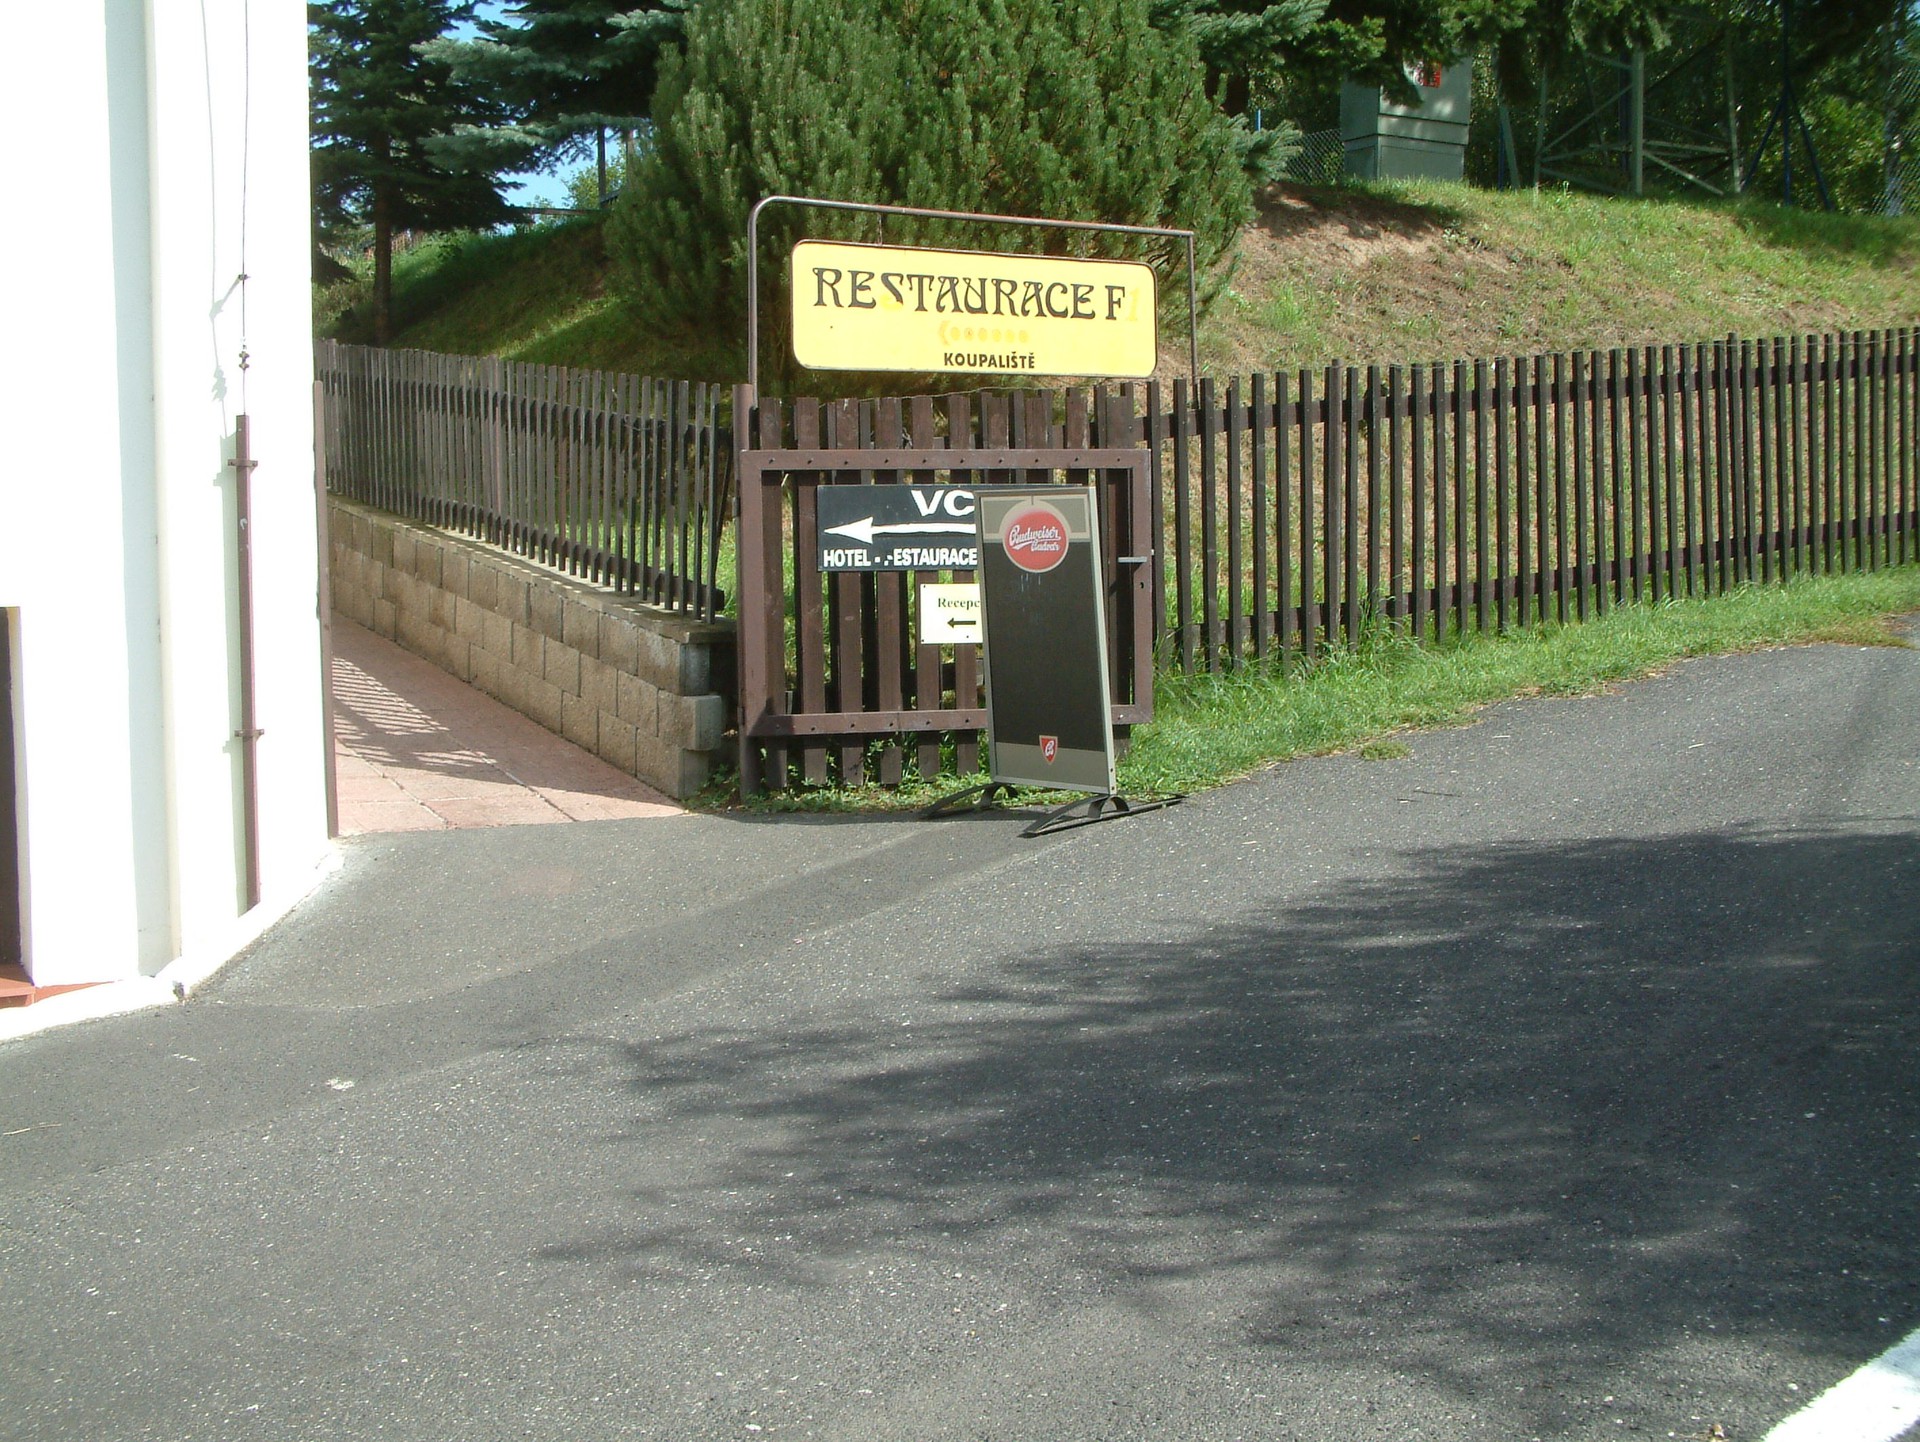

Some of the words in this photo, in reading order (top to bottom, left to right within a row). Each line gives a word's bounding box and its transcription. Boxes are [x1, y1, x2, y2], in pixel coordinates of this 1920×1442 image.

[812, 267, 1096, 320] RESTAURACE
[943, 351, 1036, 370] KOUPALIŠTĚ
[823, 548, 872, 568] HOTEL
